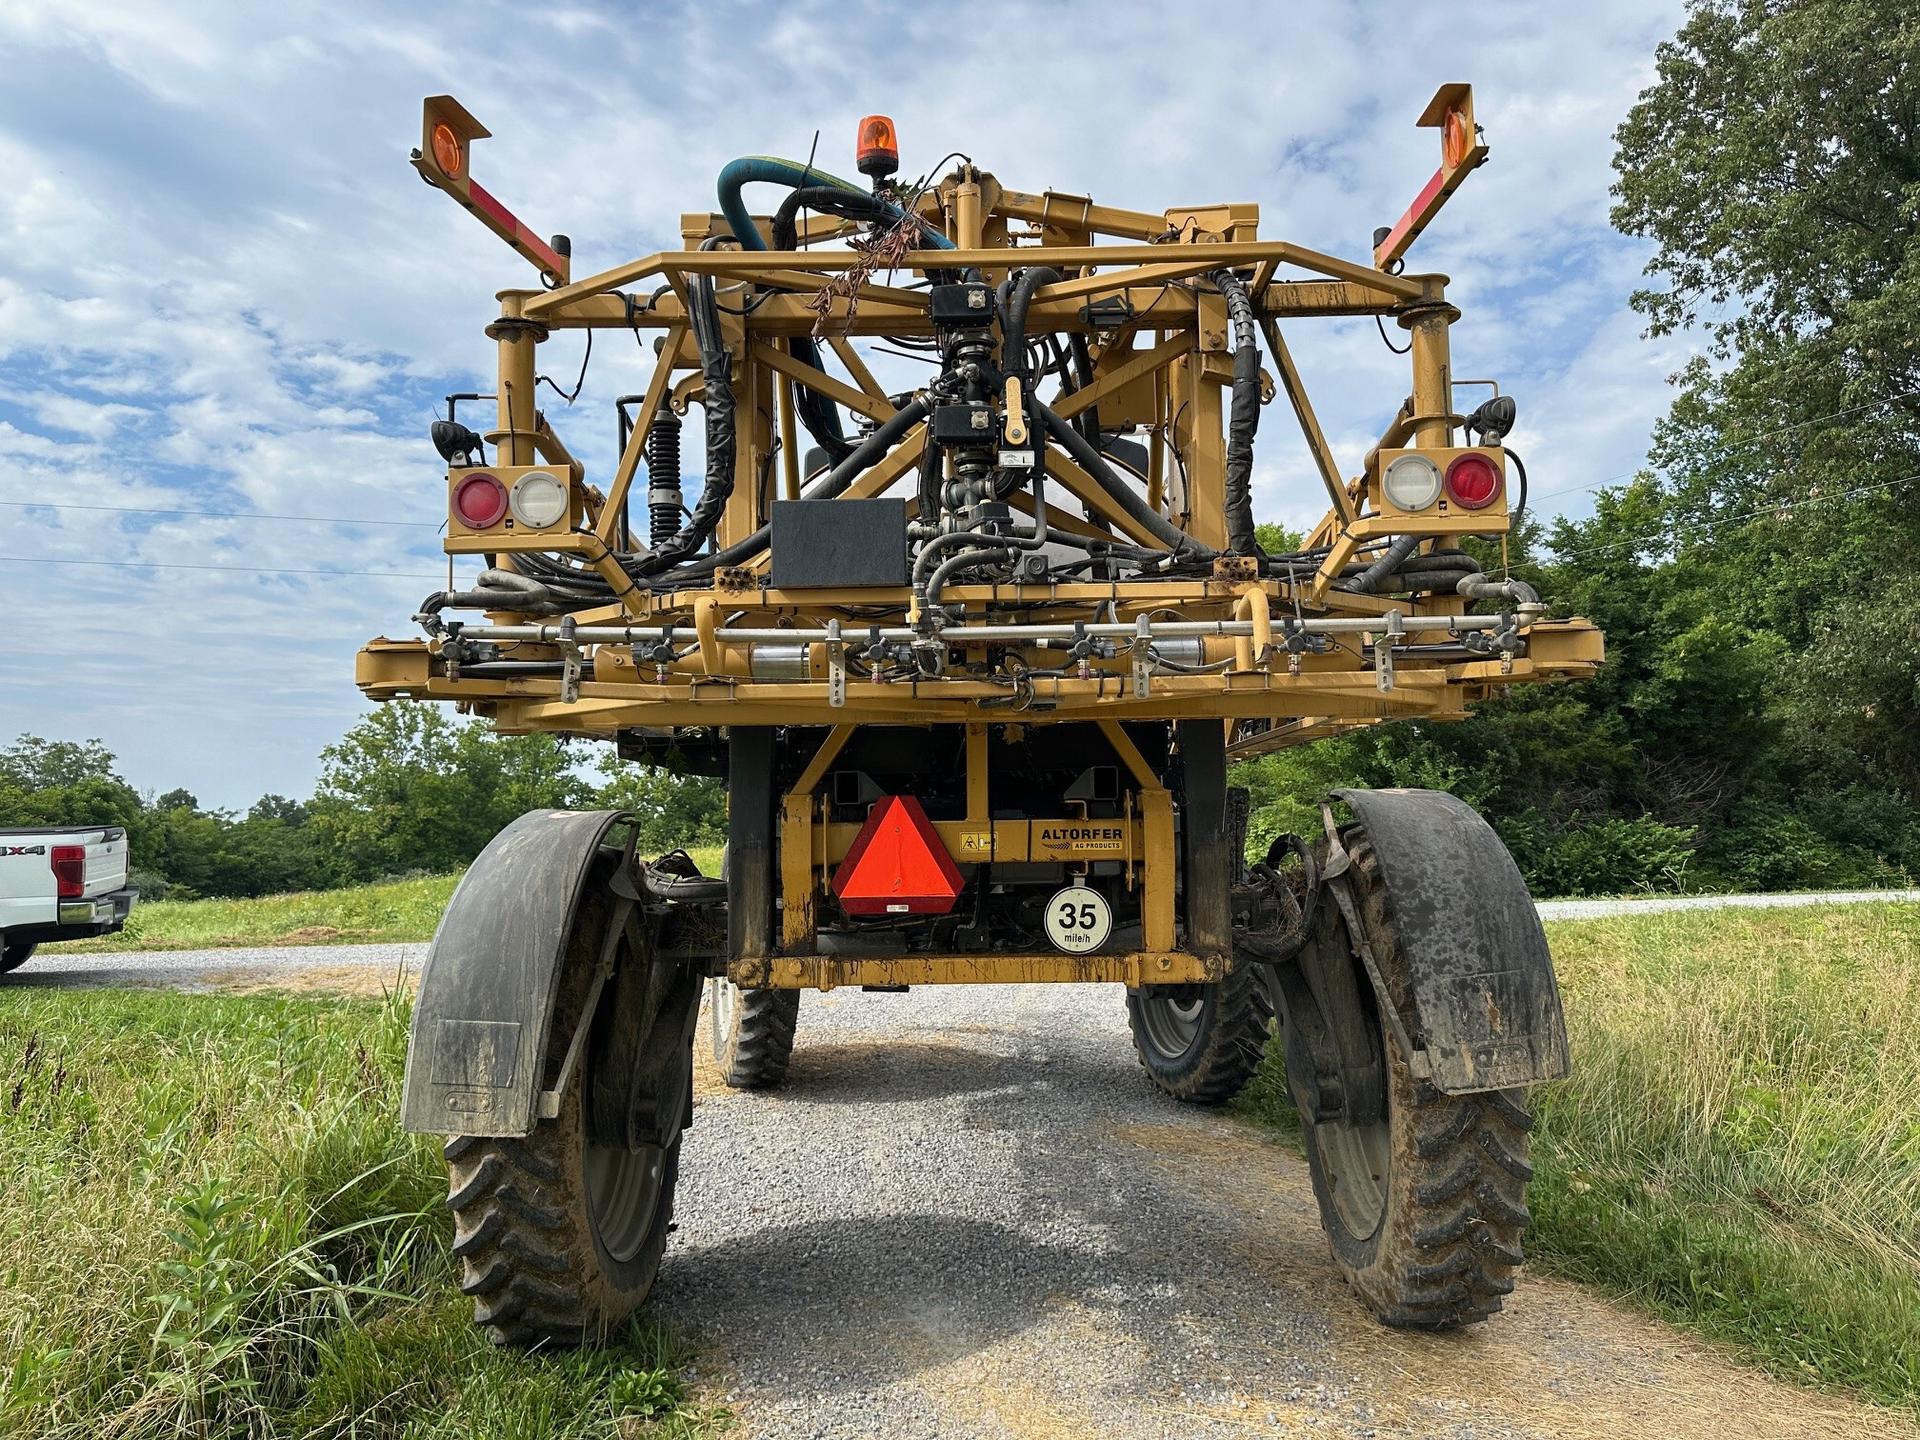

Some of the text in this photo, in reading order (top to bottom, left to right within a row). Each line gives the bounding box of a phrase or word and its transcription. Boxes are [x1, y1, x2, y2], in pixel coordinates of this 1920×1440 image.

[1042, 829, 1123, 840] ALTORFER
[1059, 903, 1096, 930] 35
[1064, 933, 1091, 943] mile/h
